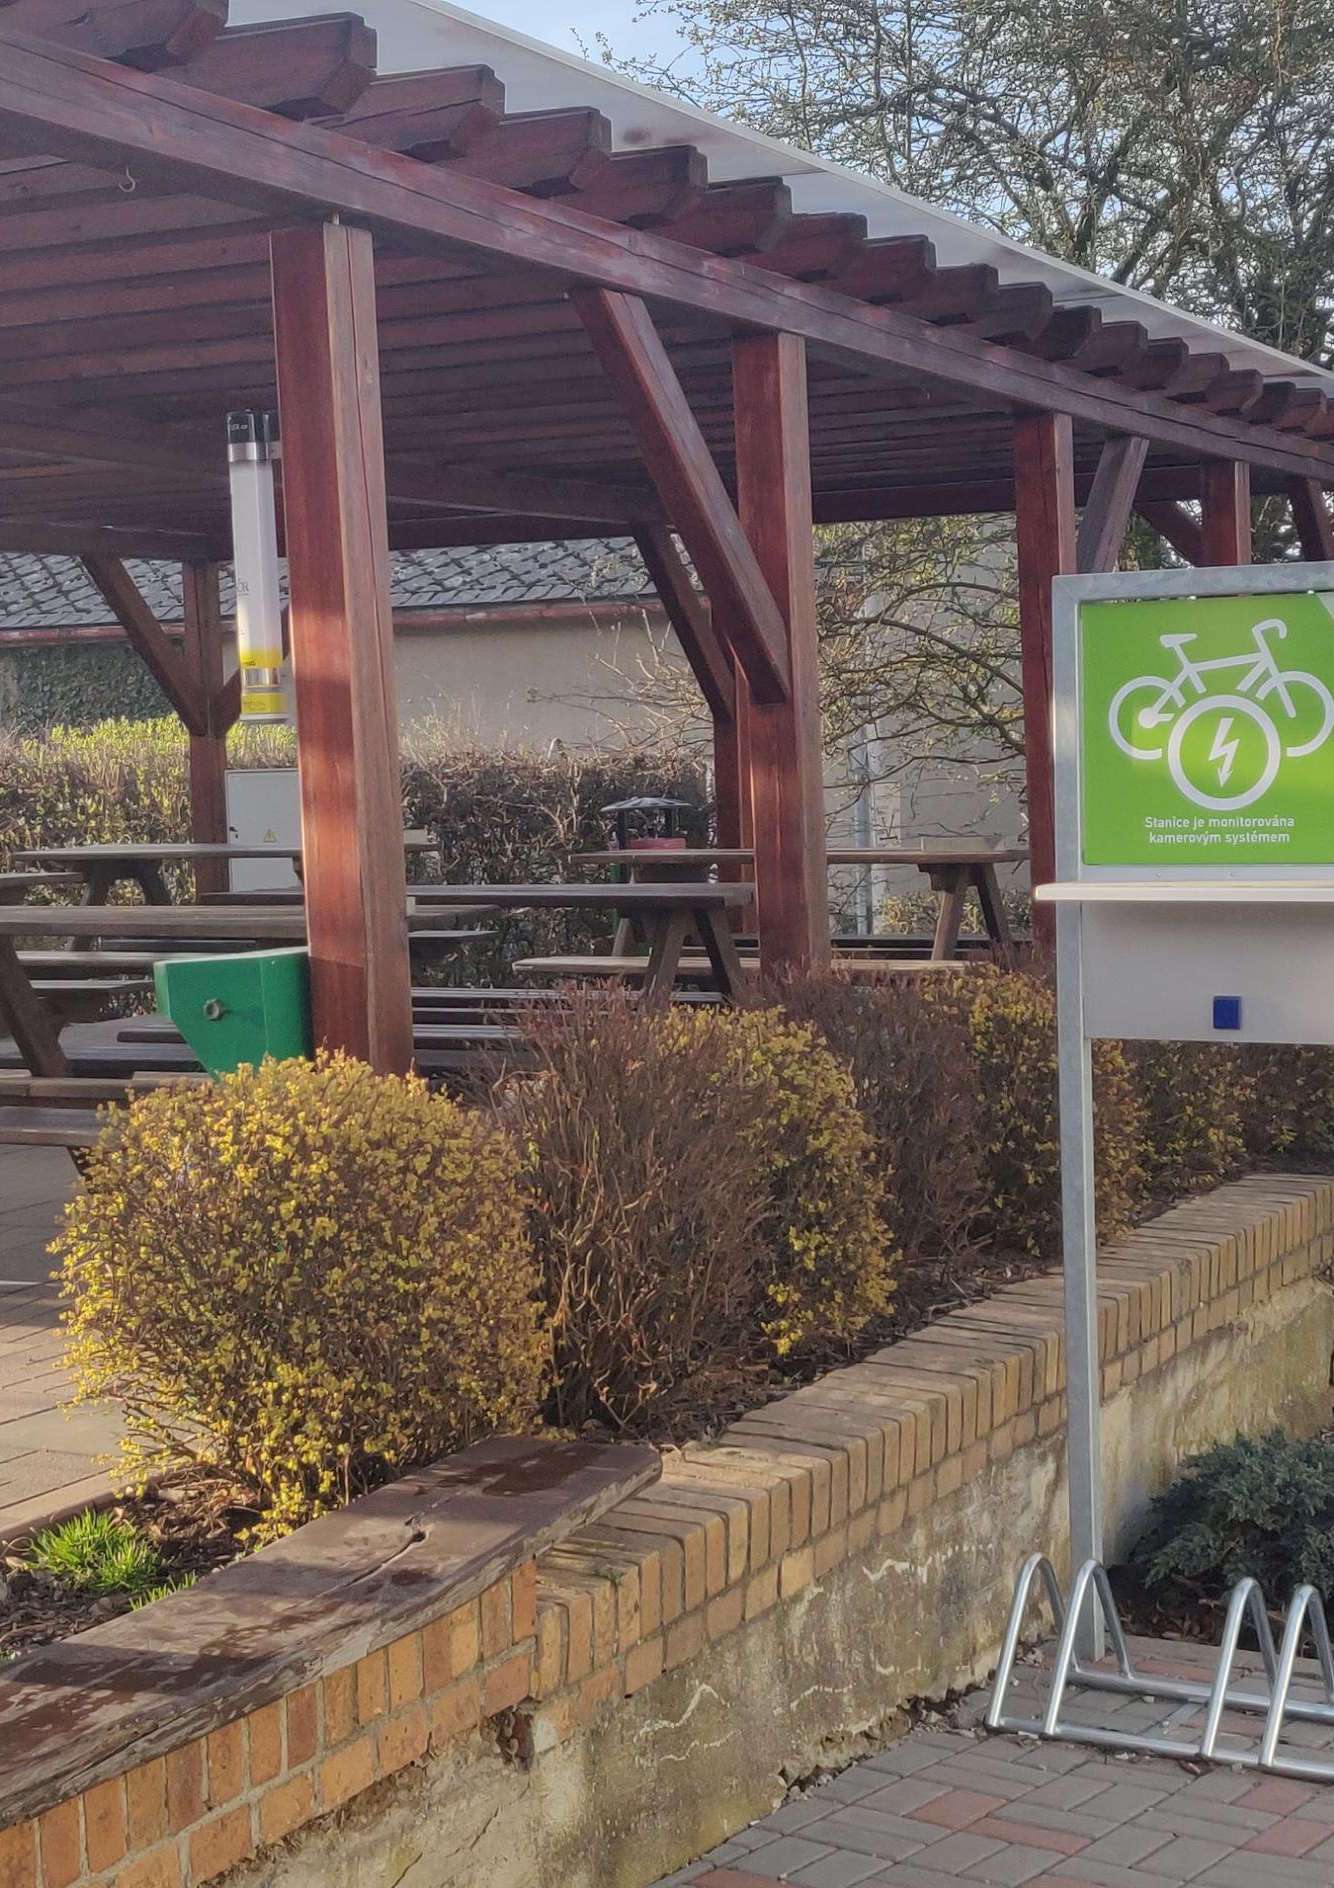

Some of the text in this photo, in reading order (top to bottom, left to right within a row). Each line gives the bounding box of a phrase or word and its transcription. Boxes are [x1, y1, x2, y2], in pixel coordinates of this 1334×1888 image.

[1144, 814, 1295, 831] Stanice je monitorována
[1148, 830, 1291, 846] kamerovým systémem
